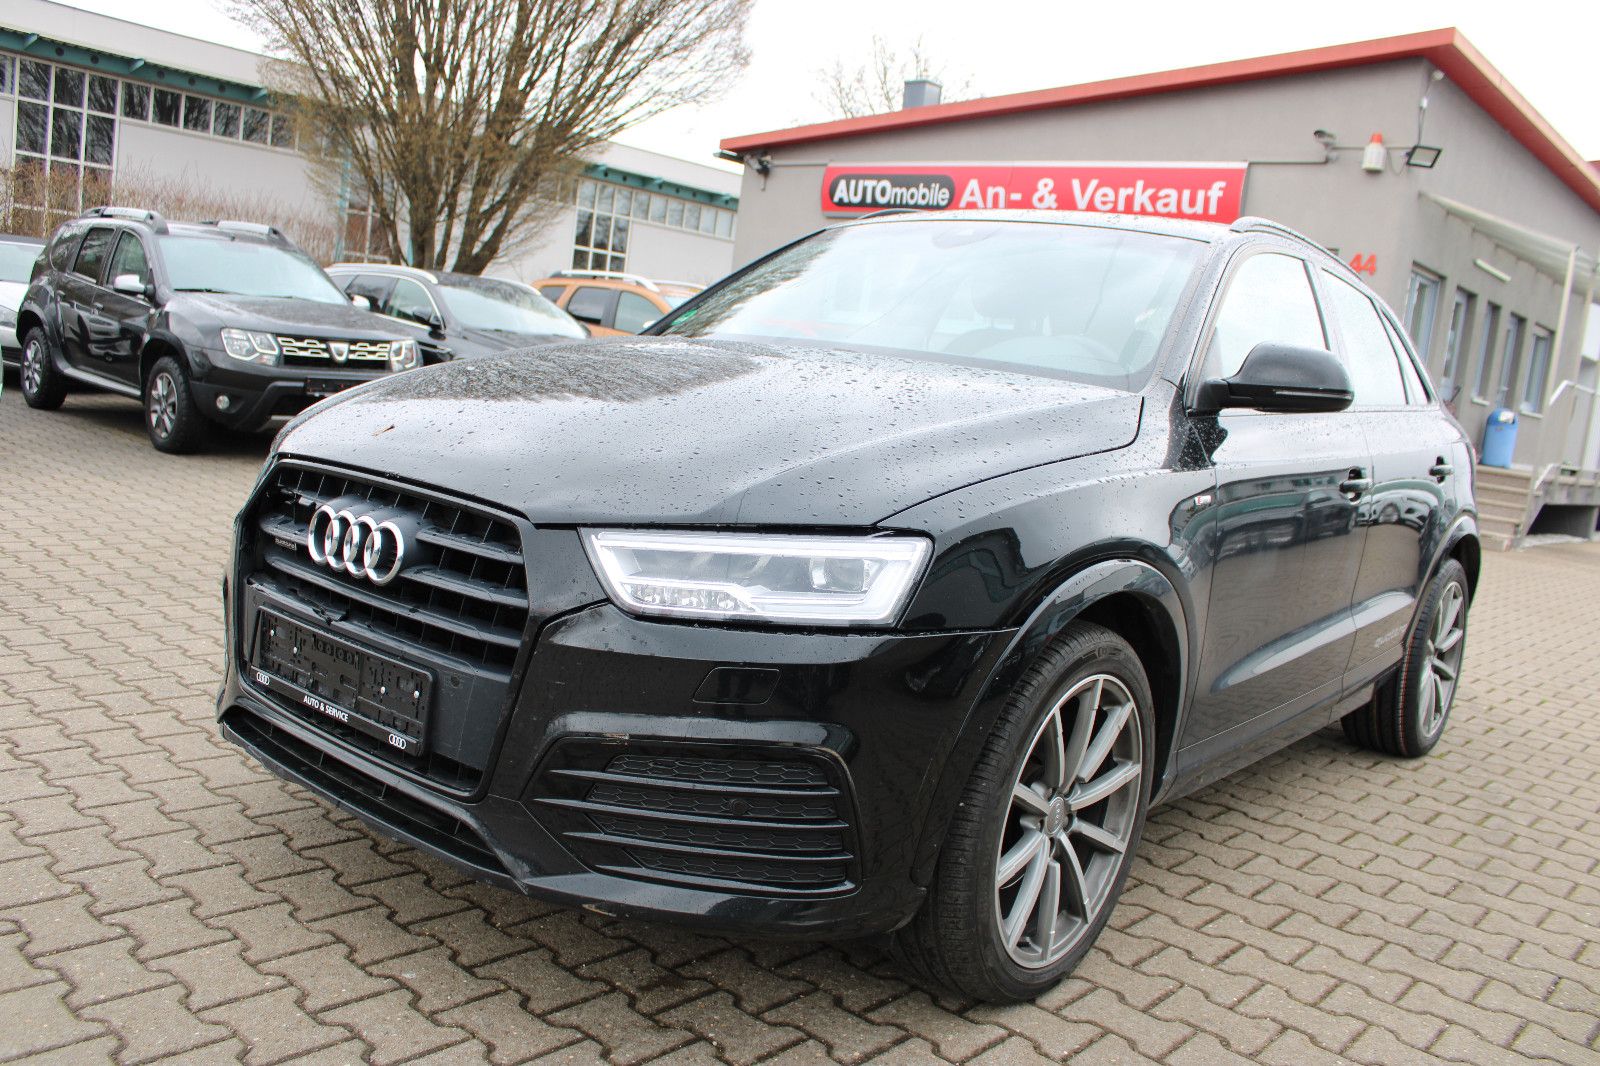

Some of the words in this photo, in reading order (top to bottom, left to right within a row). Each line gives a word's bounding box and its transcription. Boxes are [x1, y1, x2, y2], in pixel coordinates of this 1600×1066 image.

[832, 178, 950, 206] AUTOmobile
[959, 178, 1022, 209] An-
[1032, 178, 1058, 209] &
[1071, 178, 1227, 215] Verkauf
[1349, 253, 1377, 276] 44
[303, 695, 320, 709] AUTO
[319, 702, 325, 712] &
[325, 705, 349, 722] SERVICE
